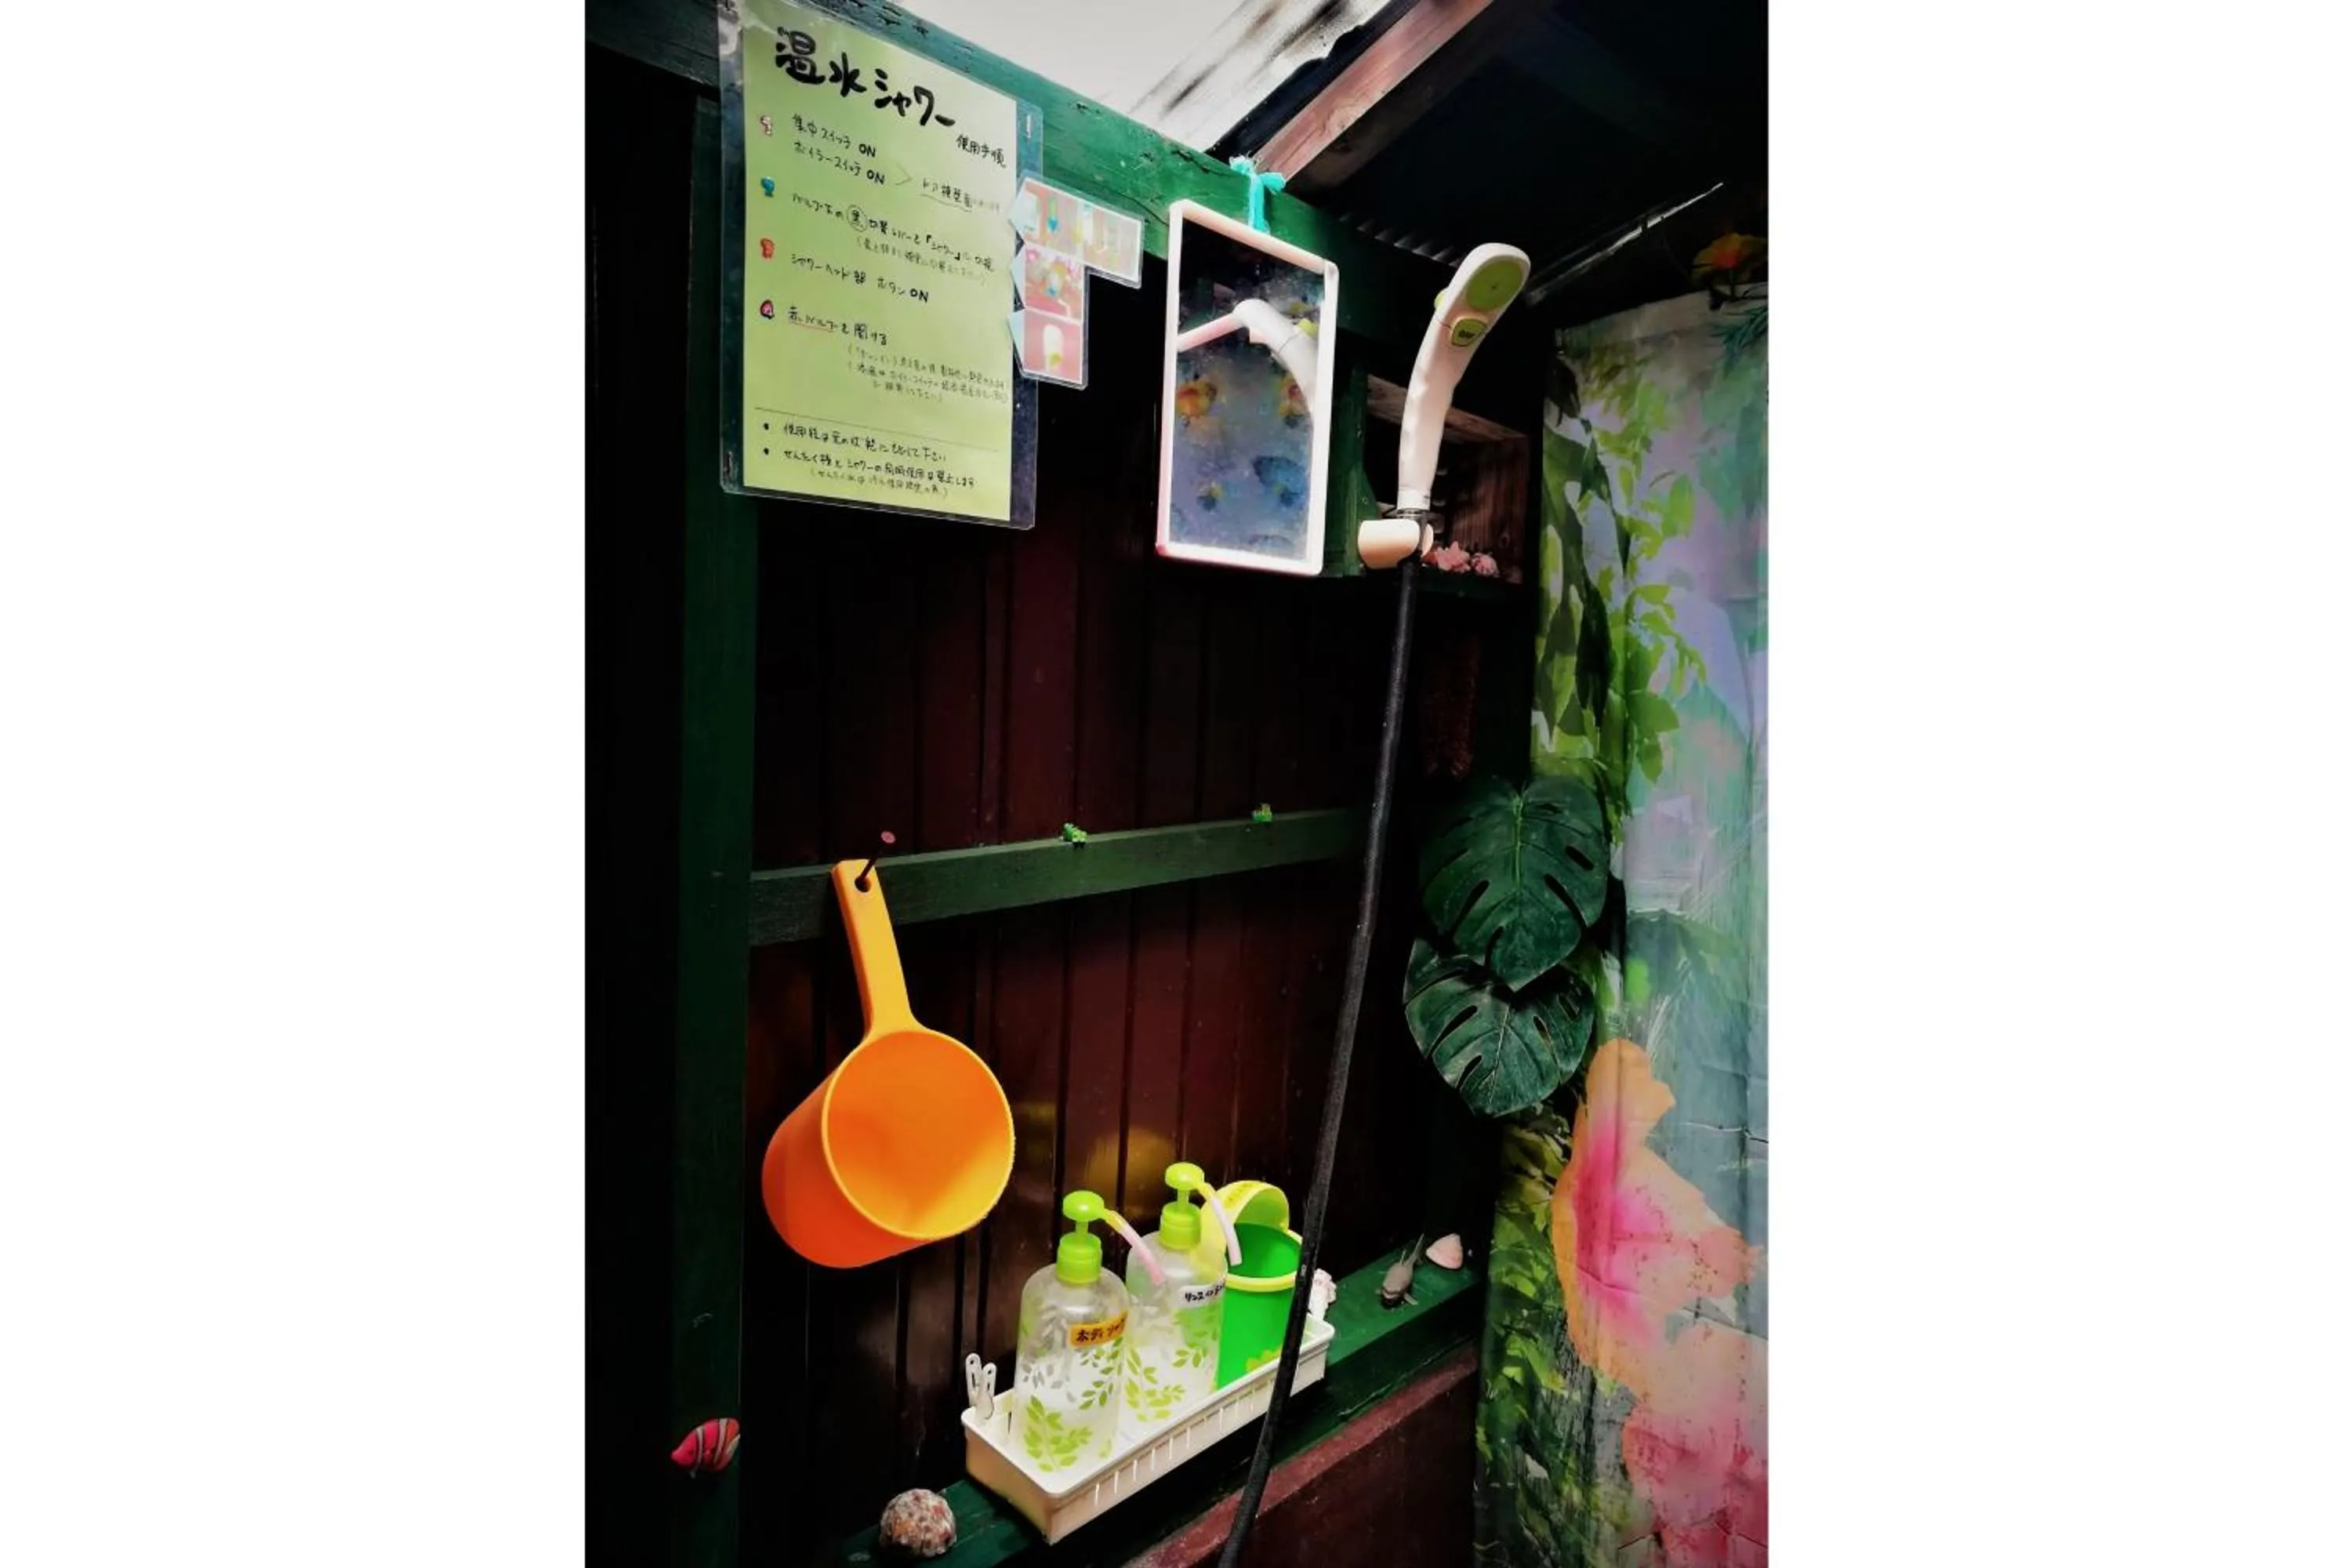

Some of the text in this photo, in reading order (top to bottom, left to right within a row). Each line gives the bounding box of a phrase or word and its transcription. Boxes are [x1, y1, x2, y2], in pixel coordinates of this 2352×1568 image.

[775, 26, 956, 126] 温水シャワー
[858, 143, 877, 158] ON
[956, 134, 1007, 169] 使用手順
[866, 169, 885, 185] ON
[909, 289, 929, 303] ON
